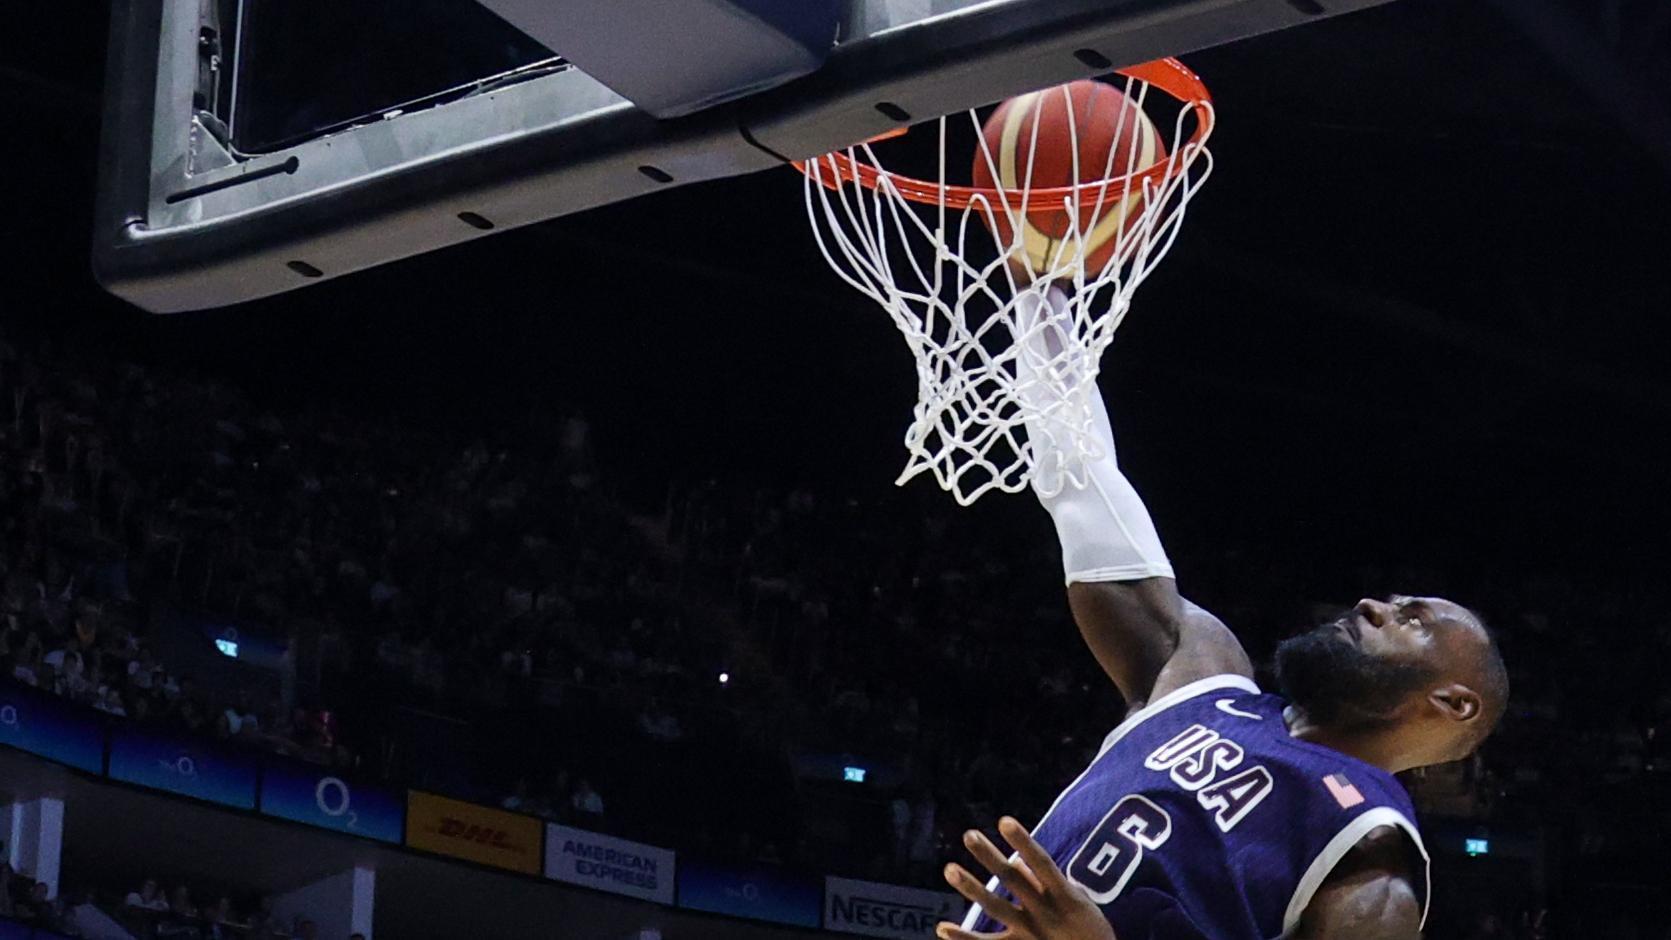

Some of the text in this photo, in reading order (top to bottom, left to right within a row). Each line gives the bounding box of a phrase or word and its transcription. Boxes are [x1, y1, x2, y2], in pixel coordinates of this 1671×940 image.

[1144, 724, 1273, 832] USA
[437, 816, 513, 849] DHL
[1067, 794, 1171, 904] 6
[562, 840, 657, 872] AMERICAN
[576, 859, 658, 890] EXPRESS
[832, 893, 947, 933] NESCAF
